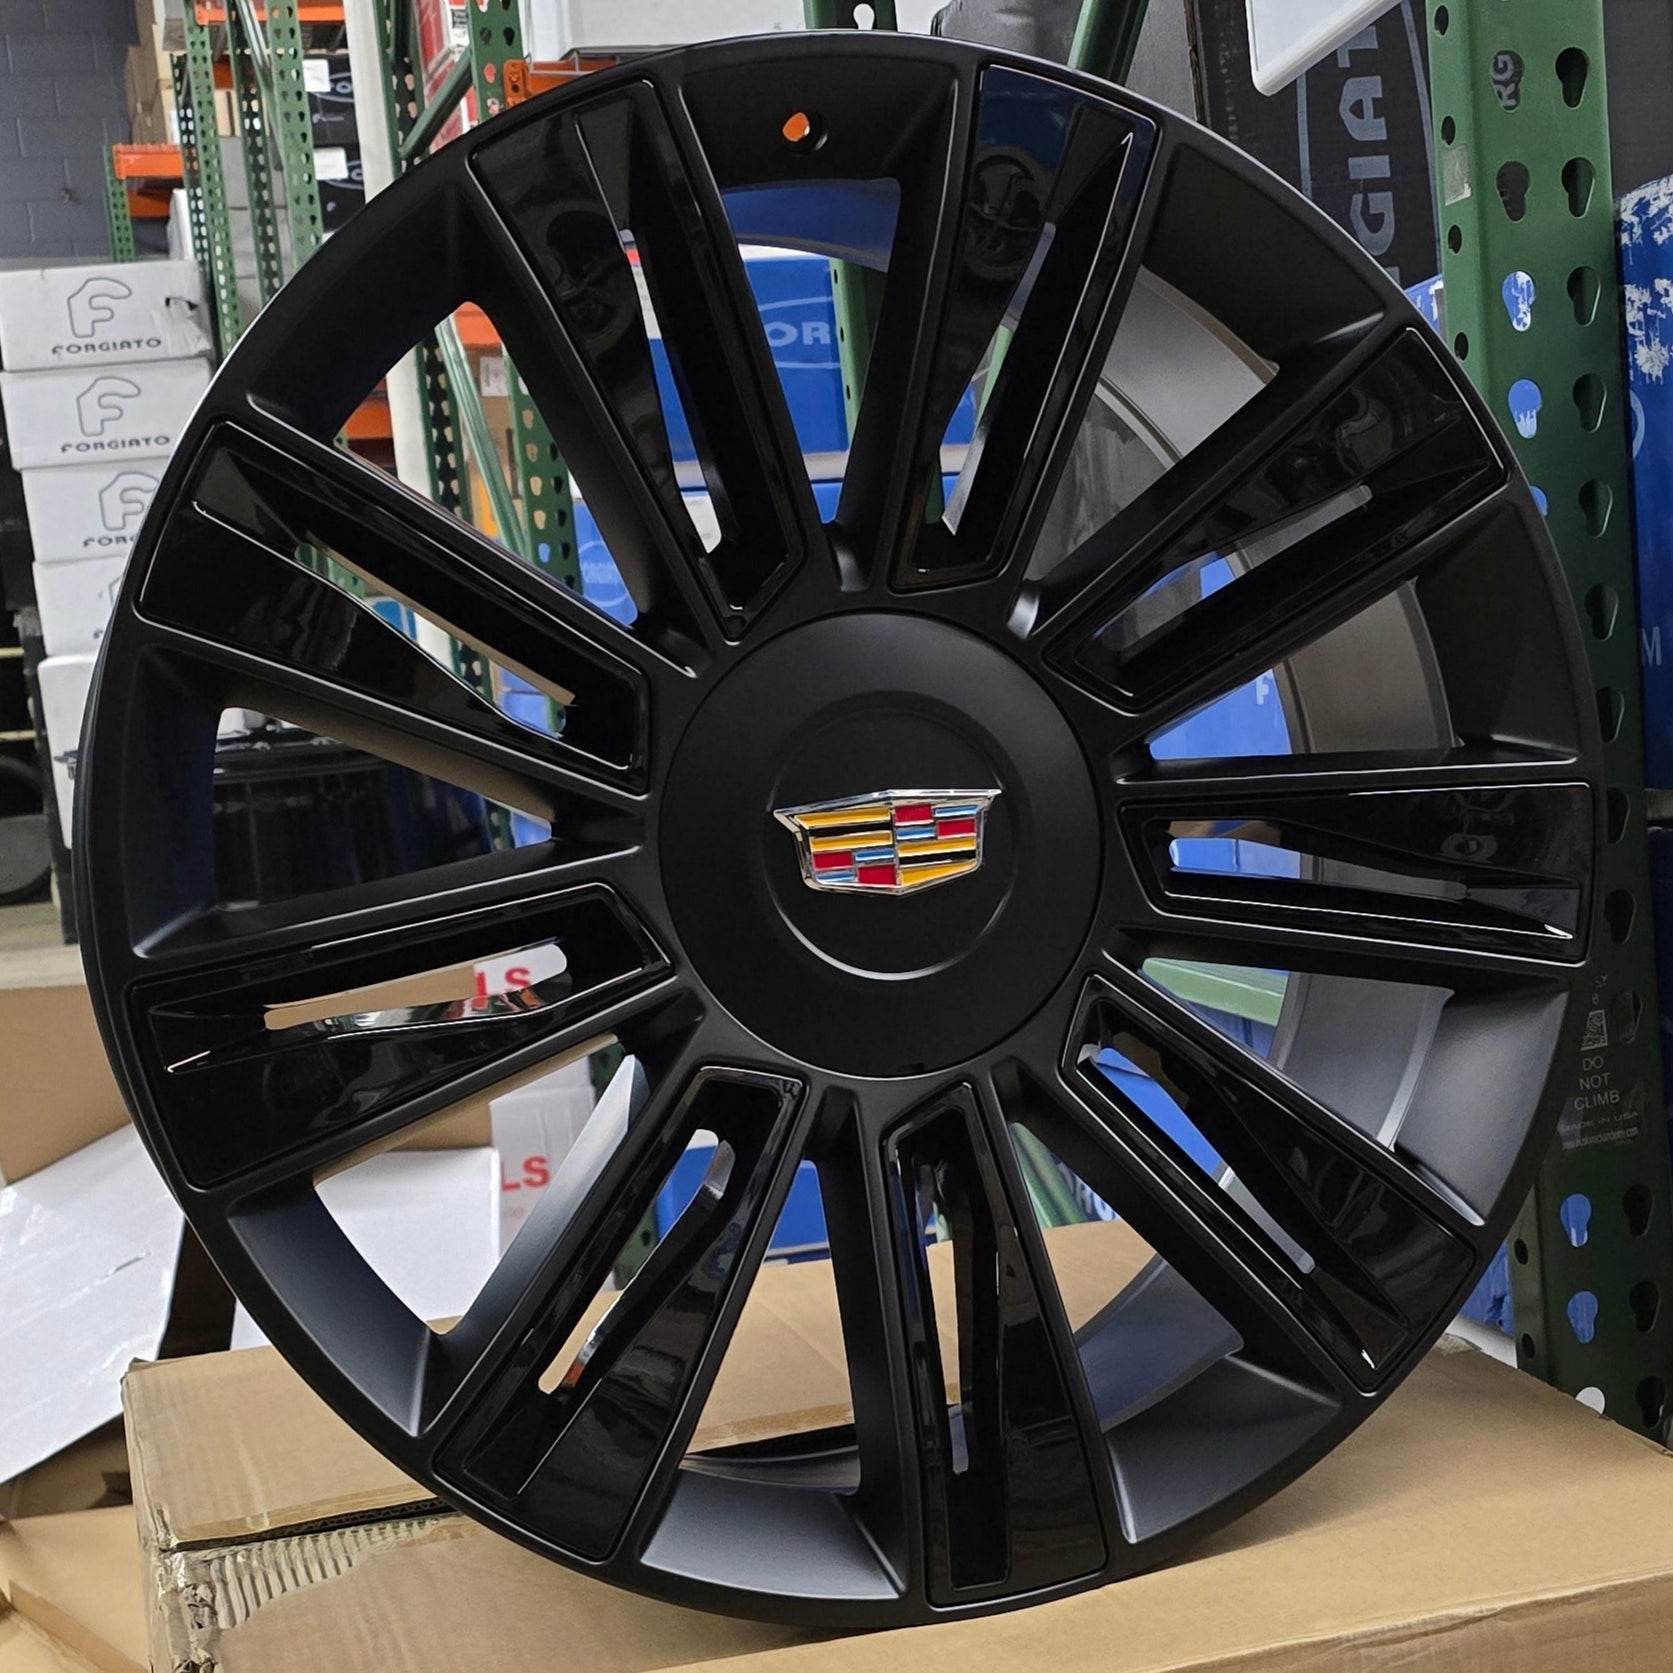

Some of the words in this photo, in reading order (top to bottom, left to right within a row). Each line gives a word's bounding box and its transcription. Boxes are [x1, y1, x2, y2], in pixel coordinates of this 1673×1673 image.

[1337, 25, 1400, 282] GIAT
[52, 337, 161, 355] FORGIATO
[61, 435, 170, 453] FORGIATO
[1582, 1055, 1604, 1071] DO
[1579, 1072, 1610, 1090] NOT
[1574, 1090, 1620, 1111] CLIMB
[500, 1155, 550, 1192] LS
